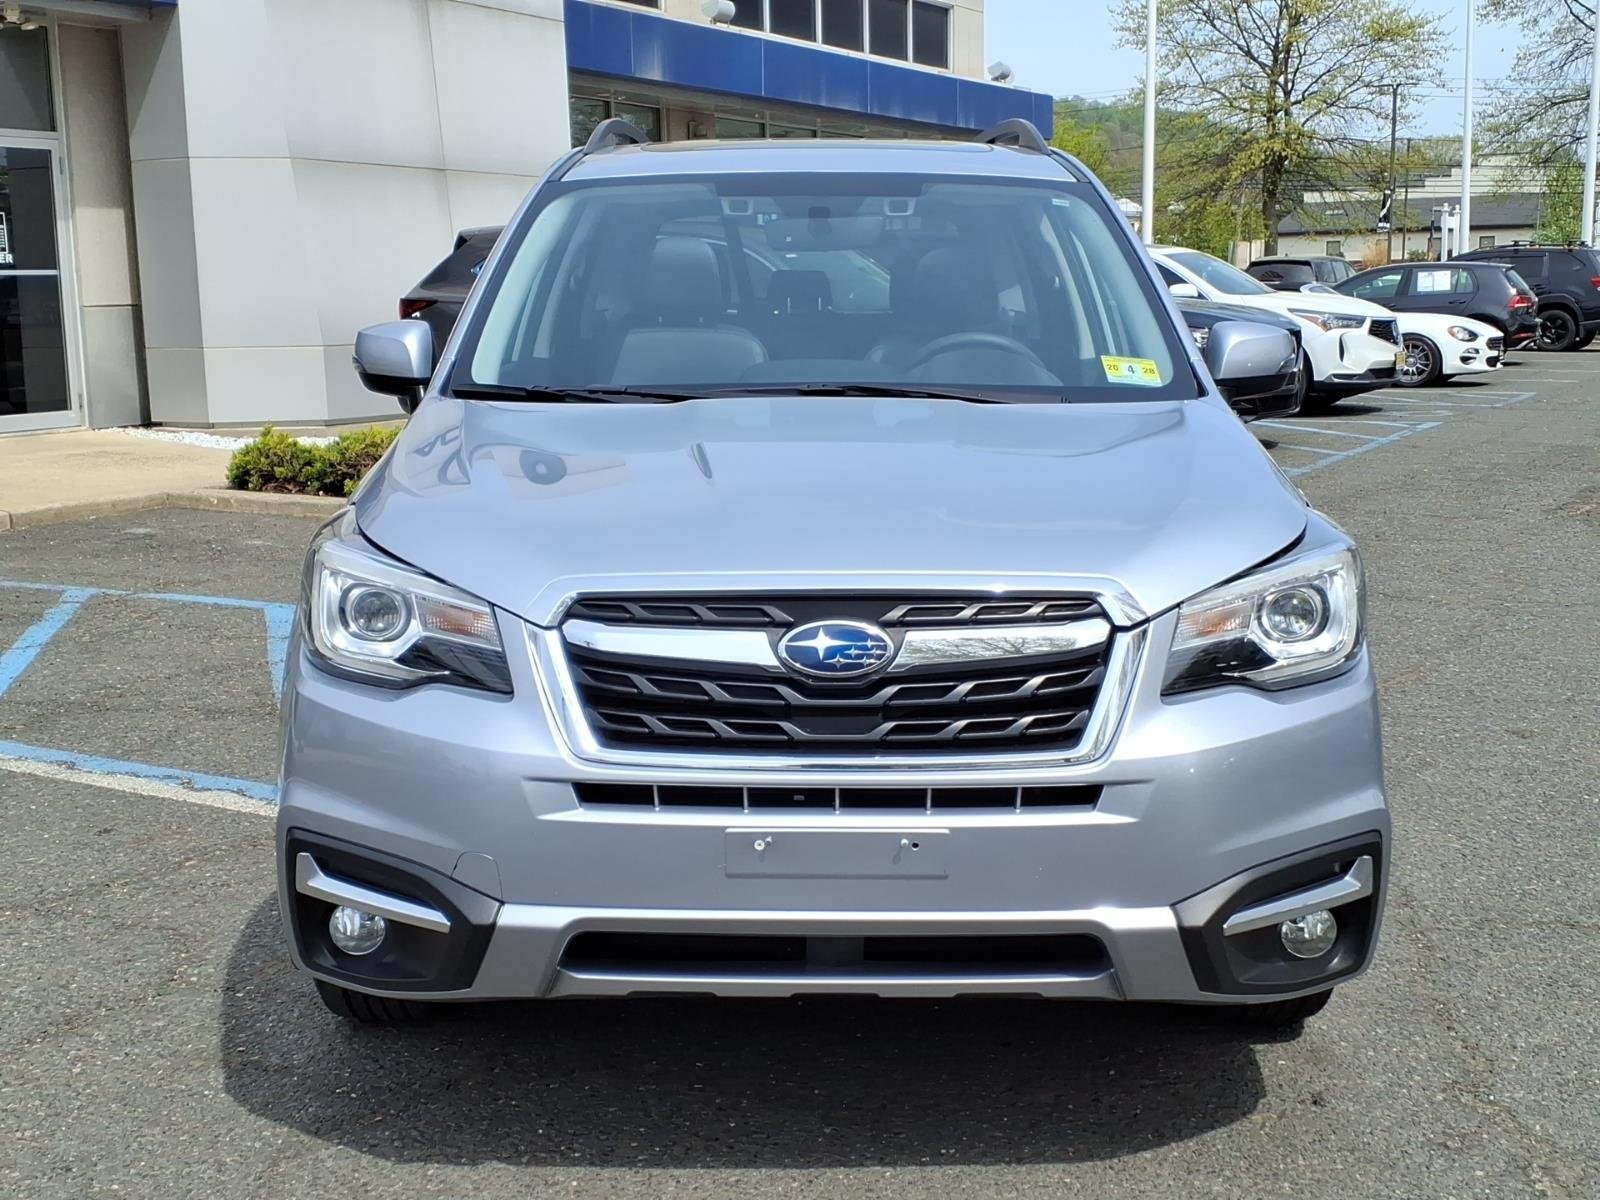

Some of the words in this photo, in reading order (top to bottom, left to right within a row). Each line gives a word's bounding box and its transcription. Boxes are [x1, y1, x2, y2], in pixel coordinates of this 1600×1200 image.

[1106, 363, 1119, 372] 20
[1127, 364, 1135, 375] 4
[1142, 366, 1156, 375] 28
